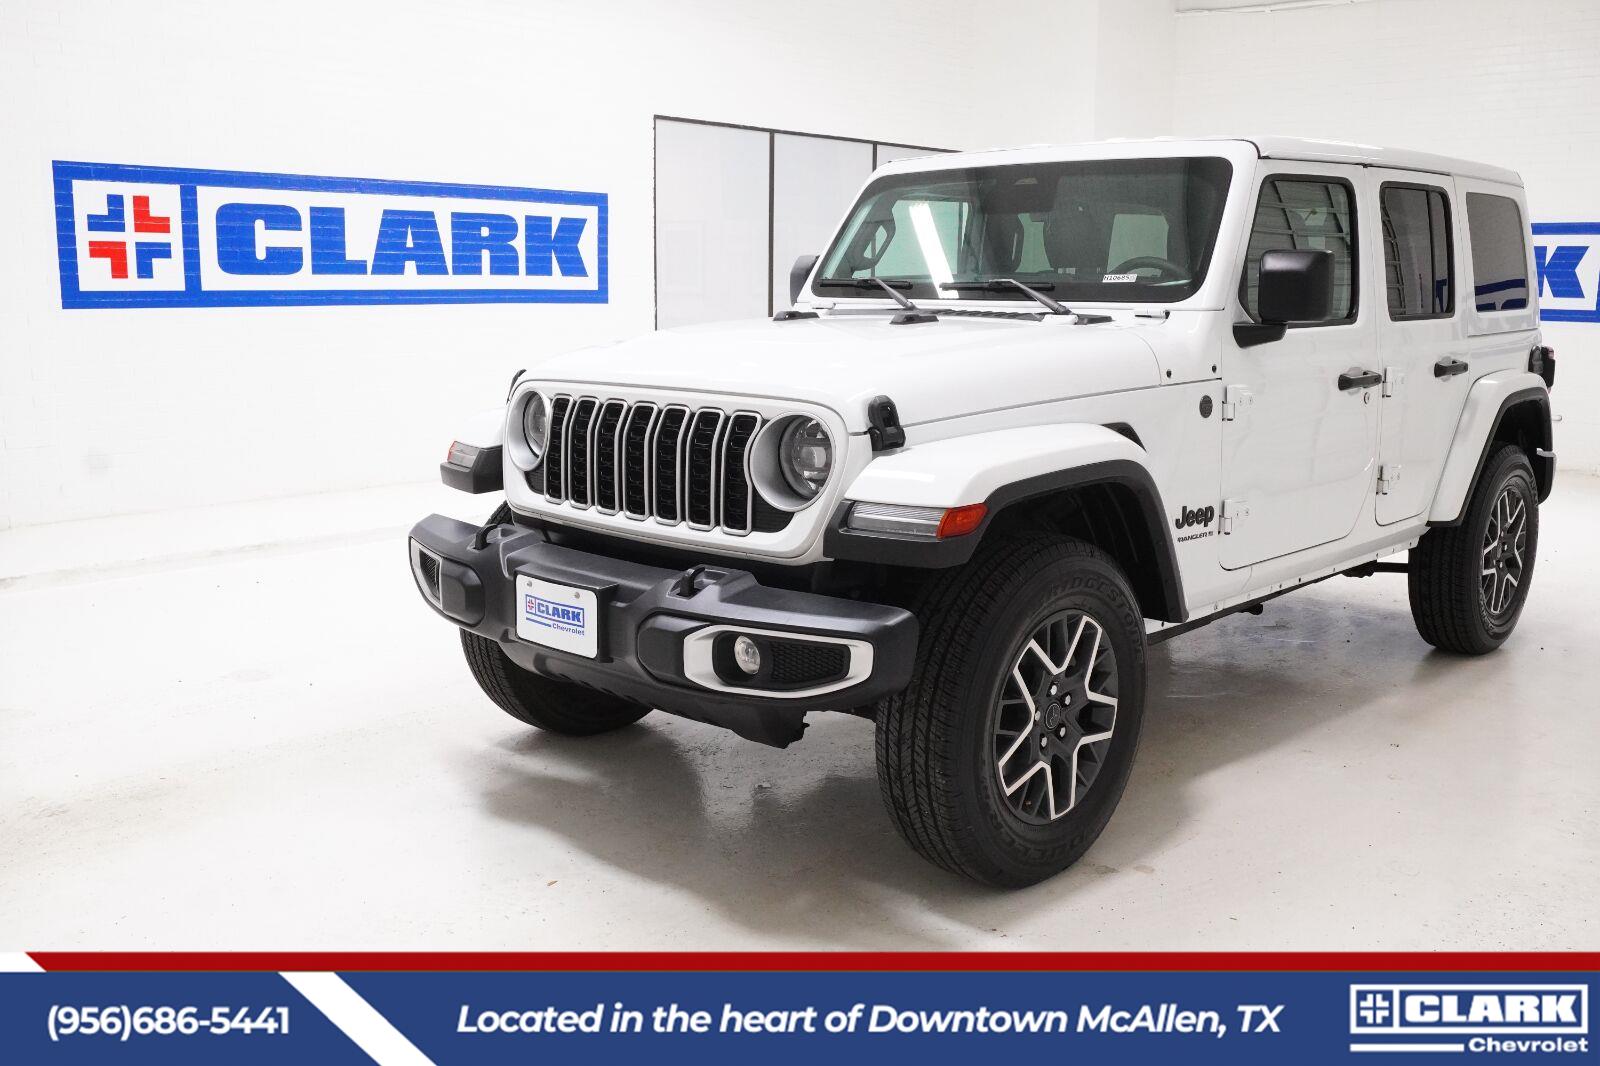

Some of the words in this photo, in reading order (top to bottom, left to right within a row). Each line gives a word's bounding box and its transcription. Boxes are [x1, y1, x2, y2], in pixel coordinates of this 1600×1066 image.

[215, 202, 589, 278] CLARK
[1175, 505, 1214, 529] Jeep
[537, 602, 582, 623] CLARK
[552, 623, 585, 636] Chevrolet
